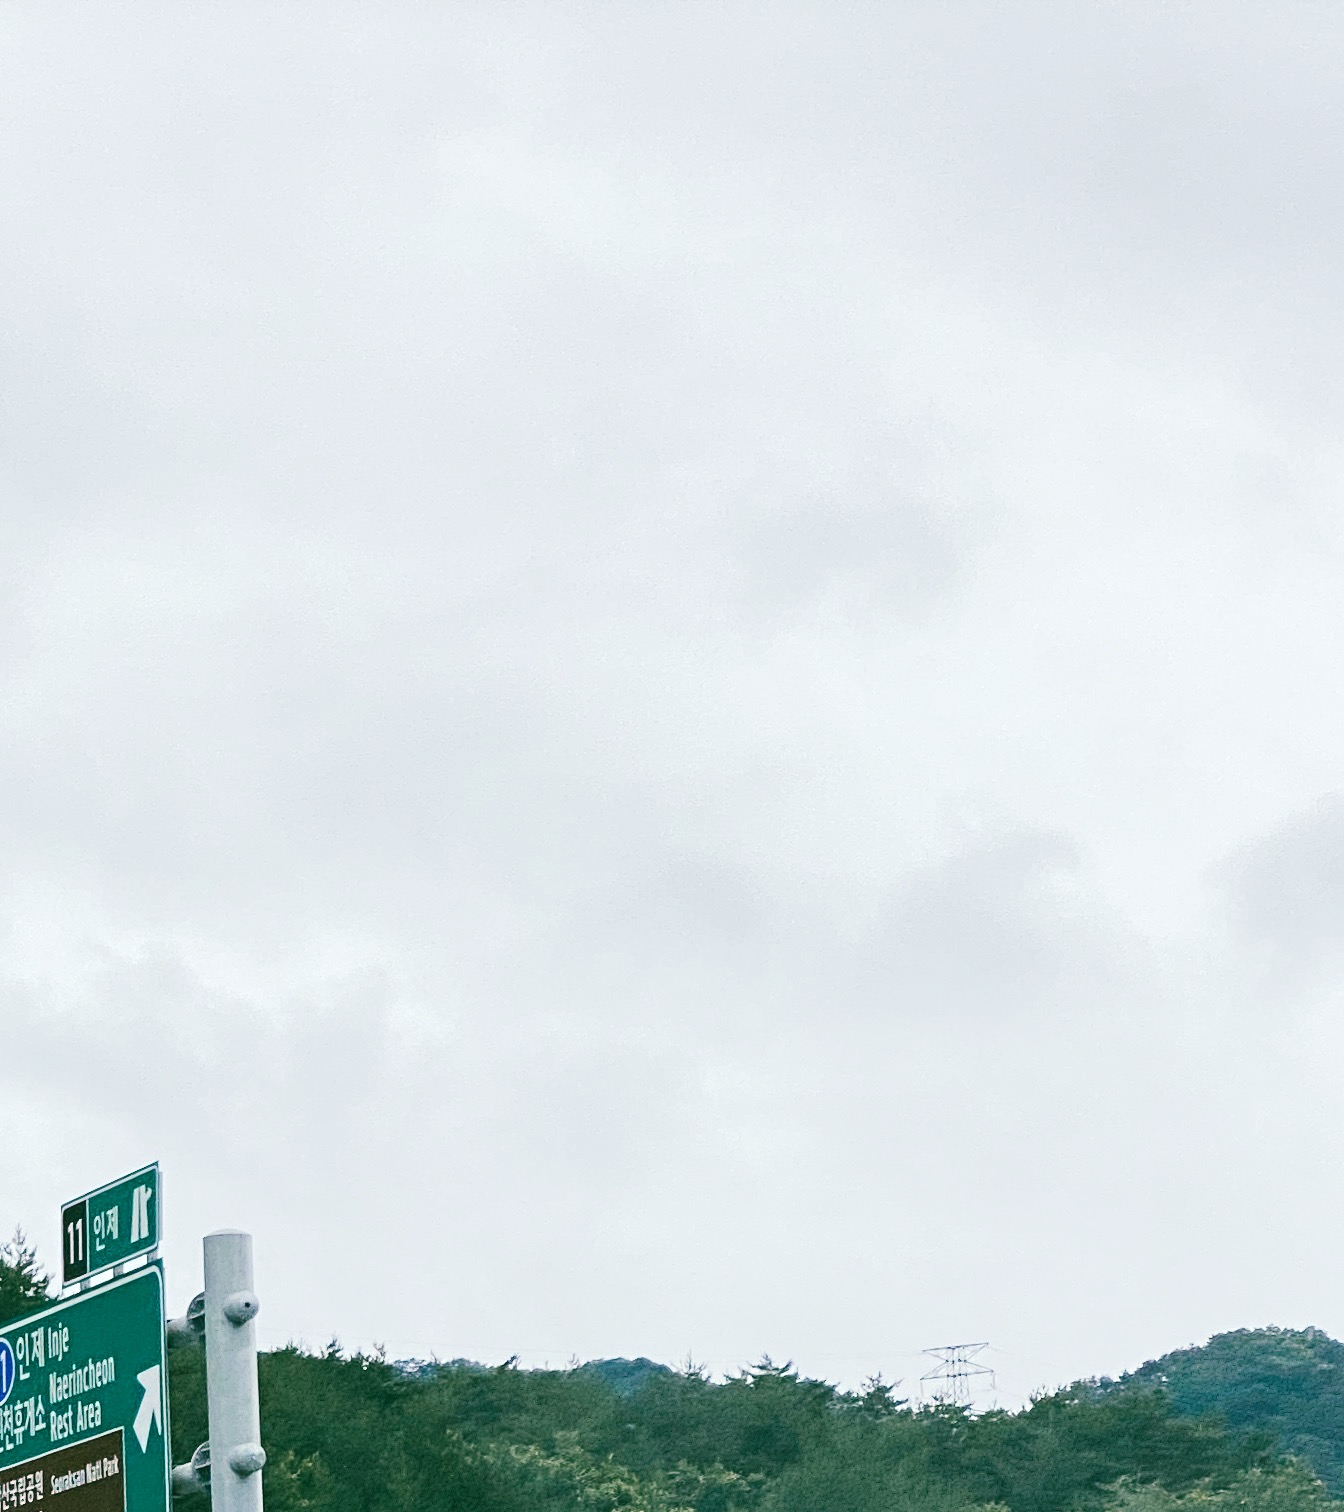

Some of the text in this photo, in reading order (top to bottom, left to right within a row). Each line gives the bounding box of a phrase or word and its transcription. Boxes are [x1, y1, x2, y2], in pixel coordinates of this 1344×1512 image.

[67, 1205, 119, 1264] 11 인제
[16, 1322, 70, 1380] 인제 Inje
[49, 1356, 116, 1404] Naerincheon
[50, 1400, 102, 1442] Rest Area
[102, 1454, 120, 1479] Park
